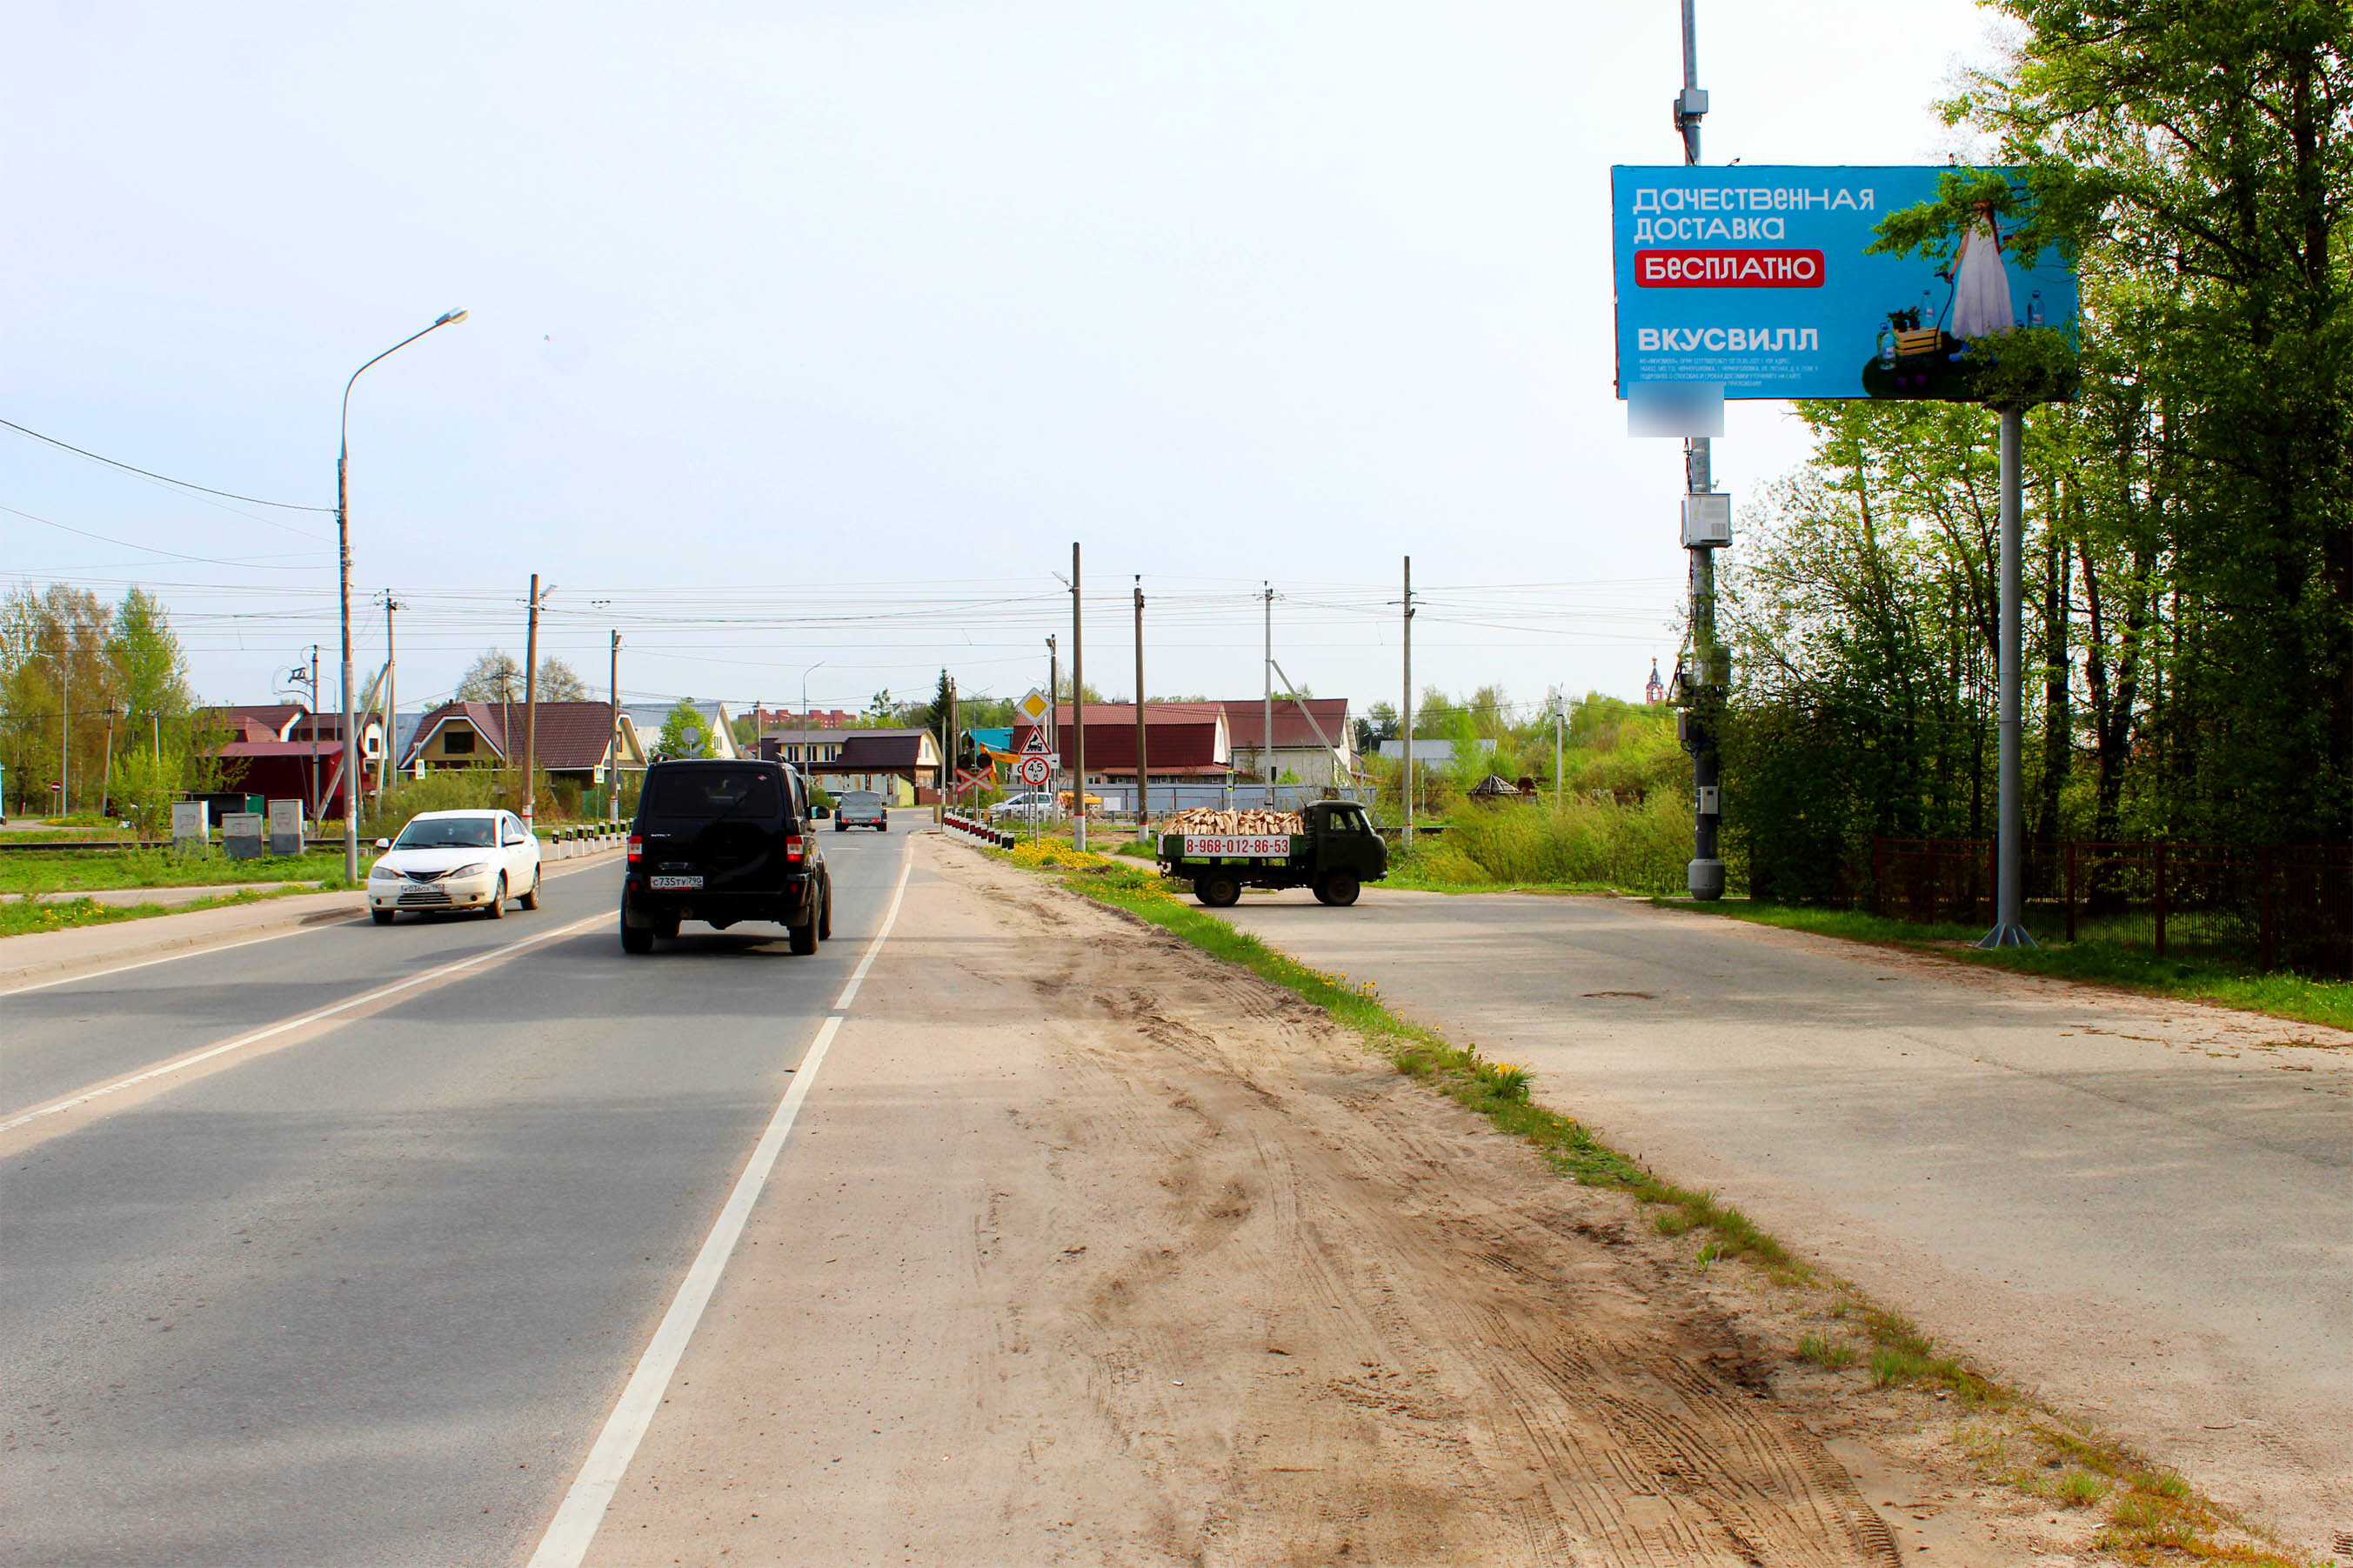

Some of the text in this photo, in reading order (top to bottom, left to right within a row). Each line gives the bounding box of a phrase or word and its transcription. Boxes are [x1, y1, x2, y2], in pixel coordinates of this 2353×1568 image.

[1634, 217, 1785, 244] ДОСТАВКА
[1645, 257, 1816, 280] БЕСПЛАТНО
[1638, 327, 1819, 351] ВКУСВИЛЛ
[1187, 839, 1288, 853] 8-968-012-86-53
